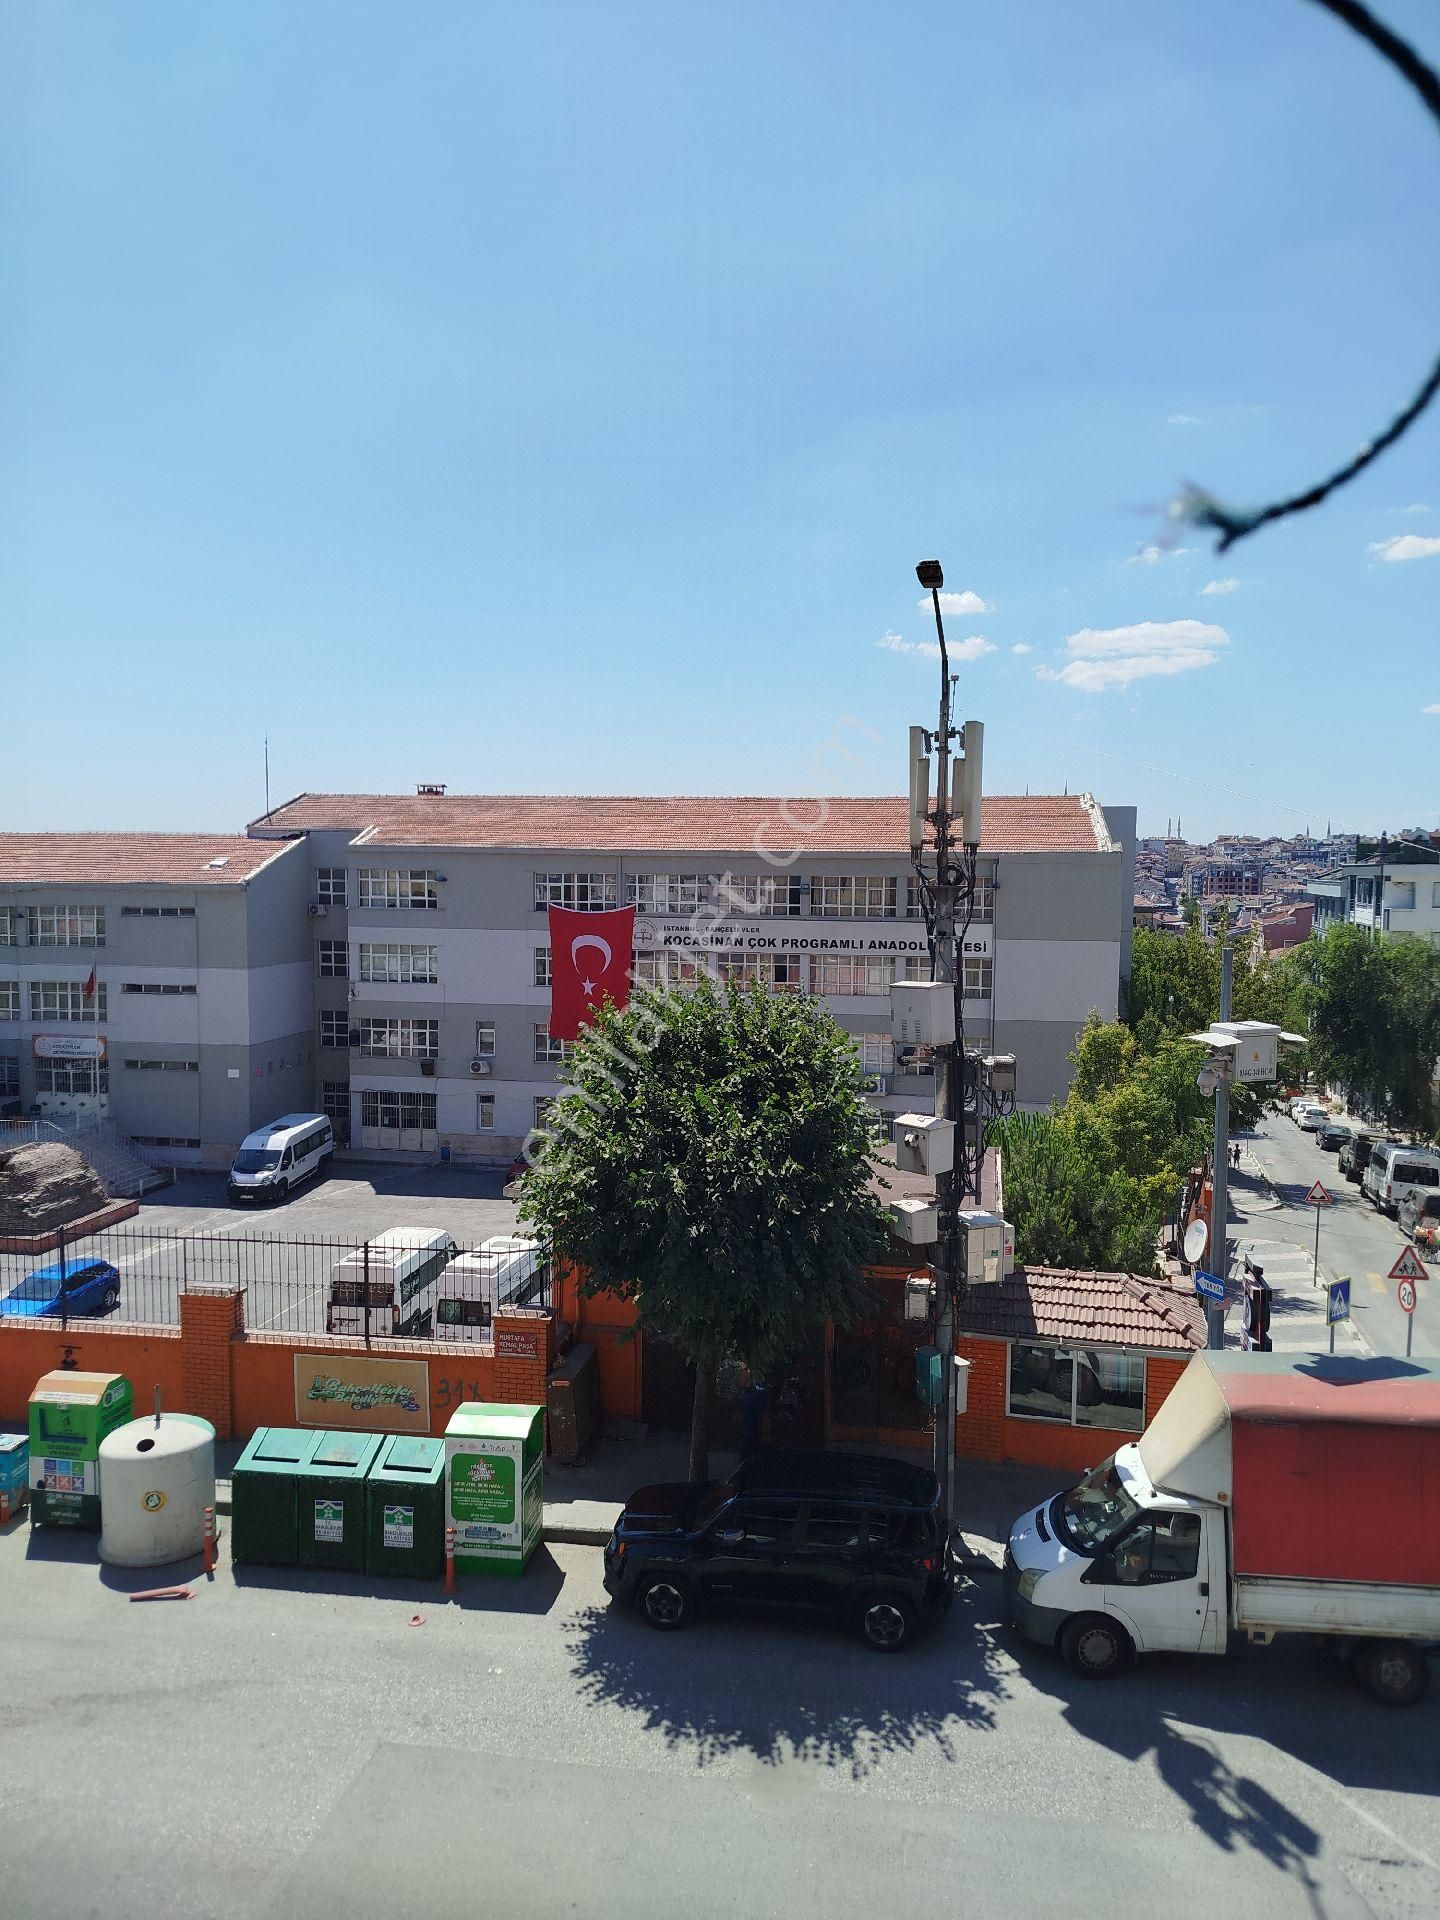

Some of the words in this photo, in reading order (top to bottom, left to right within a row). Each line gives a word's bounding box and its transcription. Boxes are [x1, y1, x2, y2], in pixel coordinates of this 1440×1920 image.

[663, 935, 744, 948] KOCASİNAN
[747, 937, 777, 949] ÇOK
[781, 938, 864, 950] PROGRAMLI
[867, 940, 933, 951] ANADOL
[1402, 1286, 1412, 1306] 20
[499, 1334, 525, 1342] MUSTAFA
